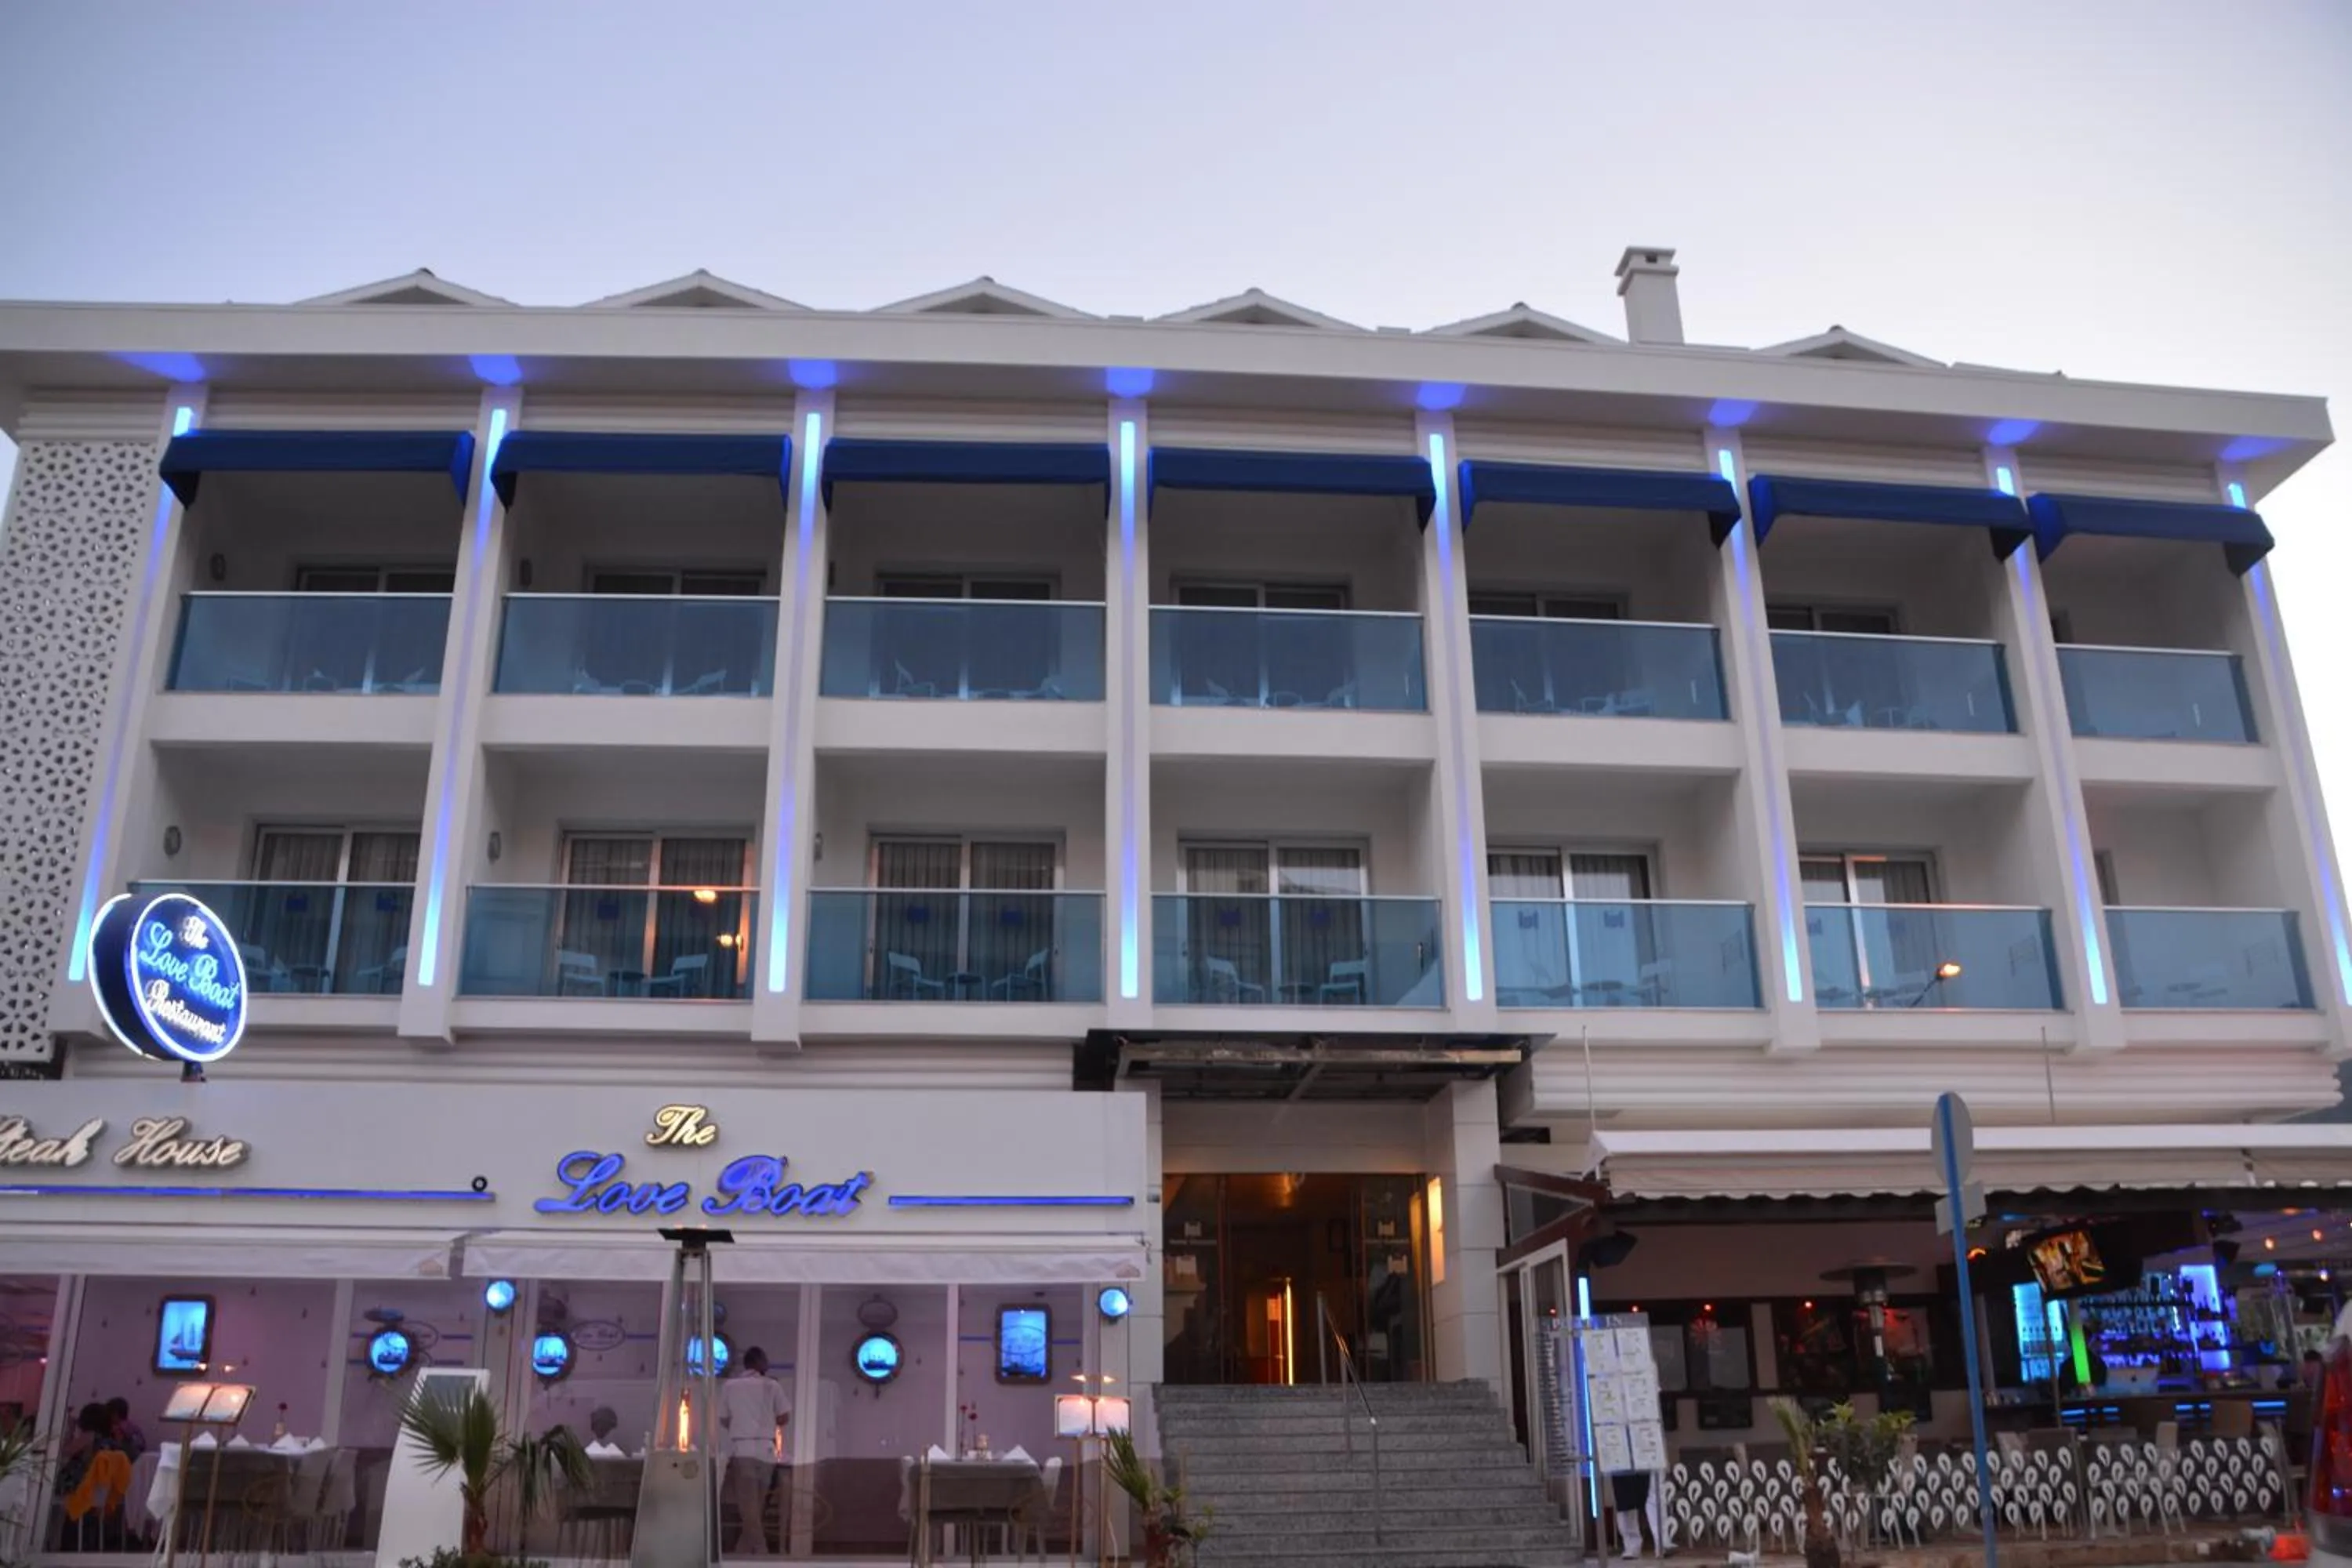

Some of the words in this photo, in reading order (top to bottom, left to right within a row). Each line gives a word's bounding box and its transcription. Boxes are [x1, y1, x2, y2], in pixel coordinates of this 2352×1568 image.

[180, 915, 209, 949] The
[139, 921, 189, 981] Love
[188, 953, 240, 1010] Boat
[113, 1116, 247, 1166] House
[644, 1103, 717, 1146] The
[533, 1150, 690, 1214] Love
[702, 1154, 872, 1216] Boat
